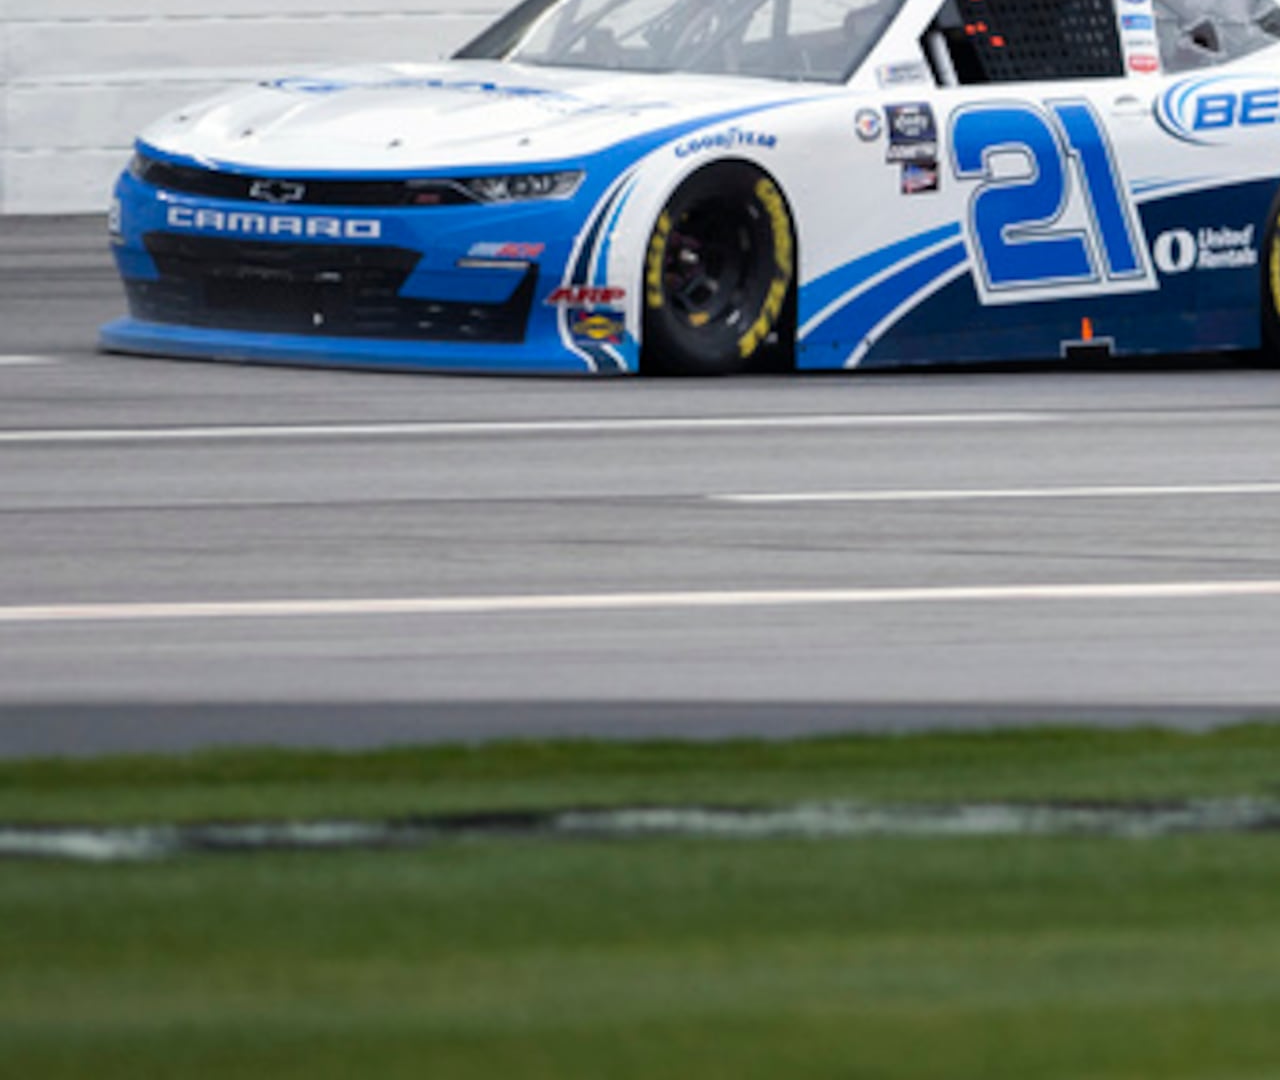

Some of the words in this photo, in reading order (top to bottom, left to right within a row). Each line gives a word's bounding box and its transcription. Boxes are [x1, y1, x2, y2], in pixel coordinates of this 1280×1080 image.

[675, 127, 778, 158] GOODYEAR
[948, 98, 1146, 292] 21
[167, 208, 381, 238] CAMARO
[1198, 225, 1254, 245] United
[548, 289, 625, 304] ARP
